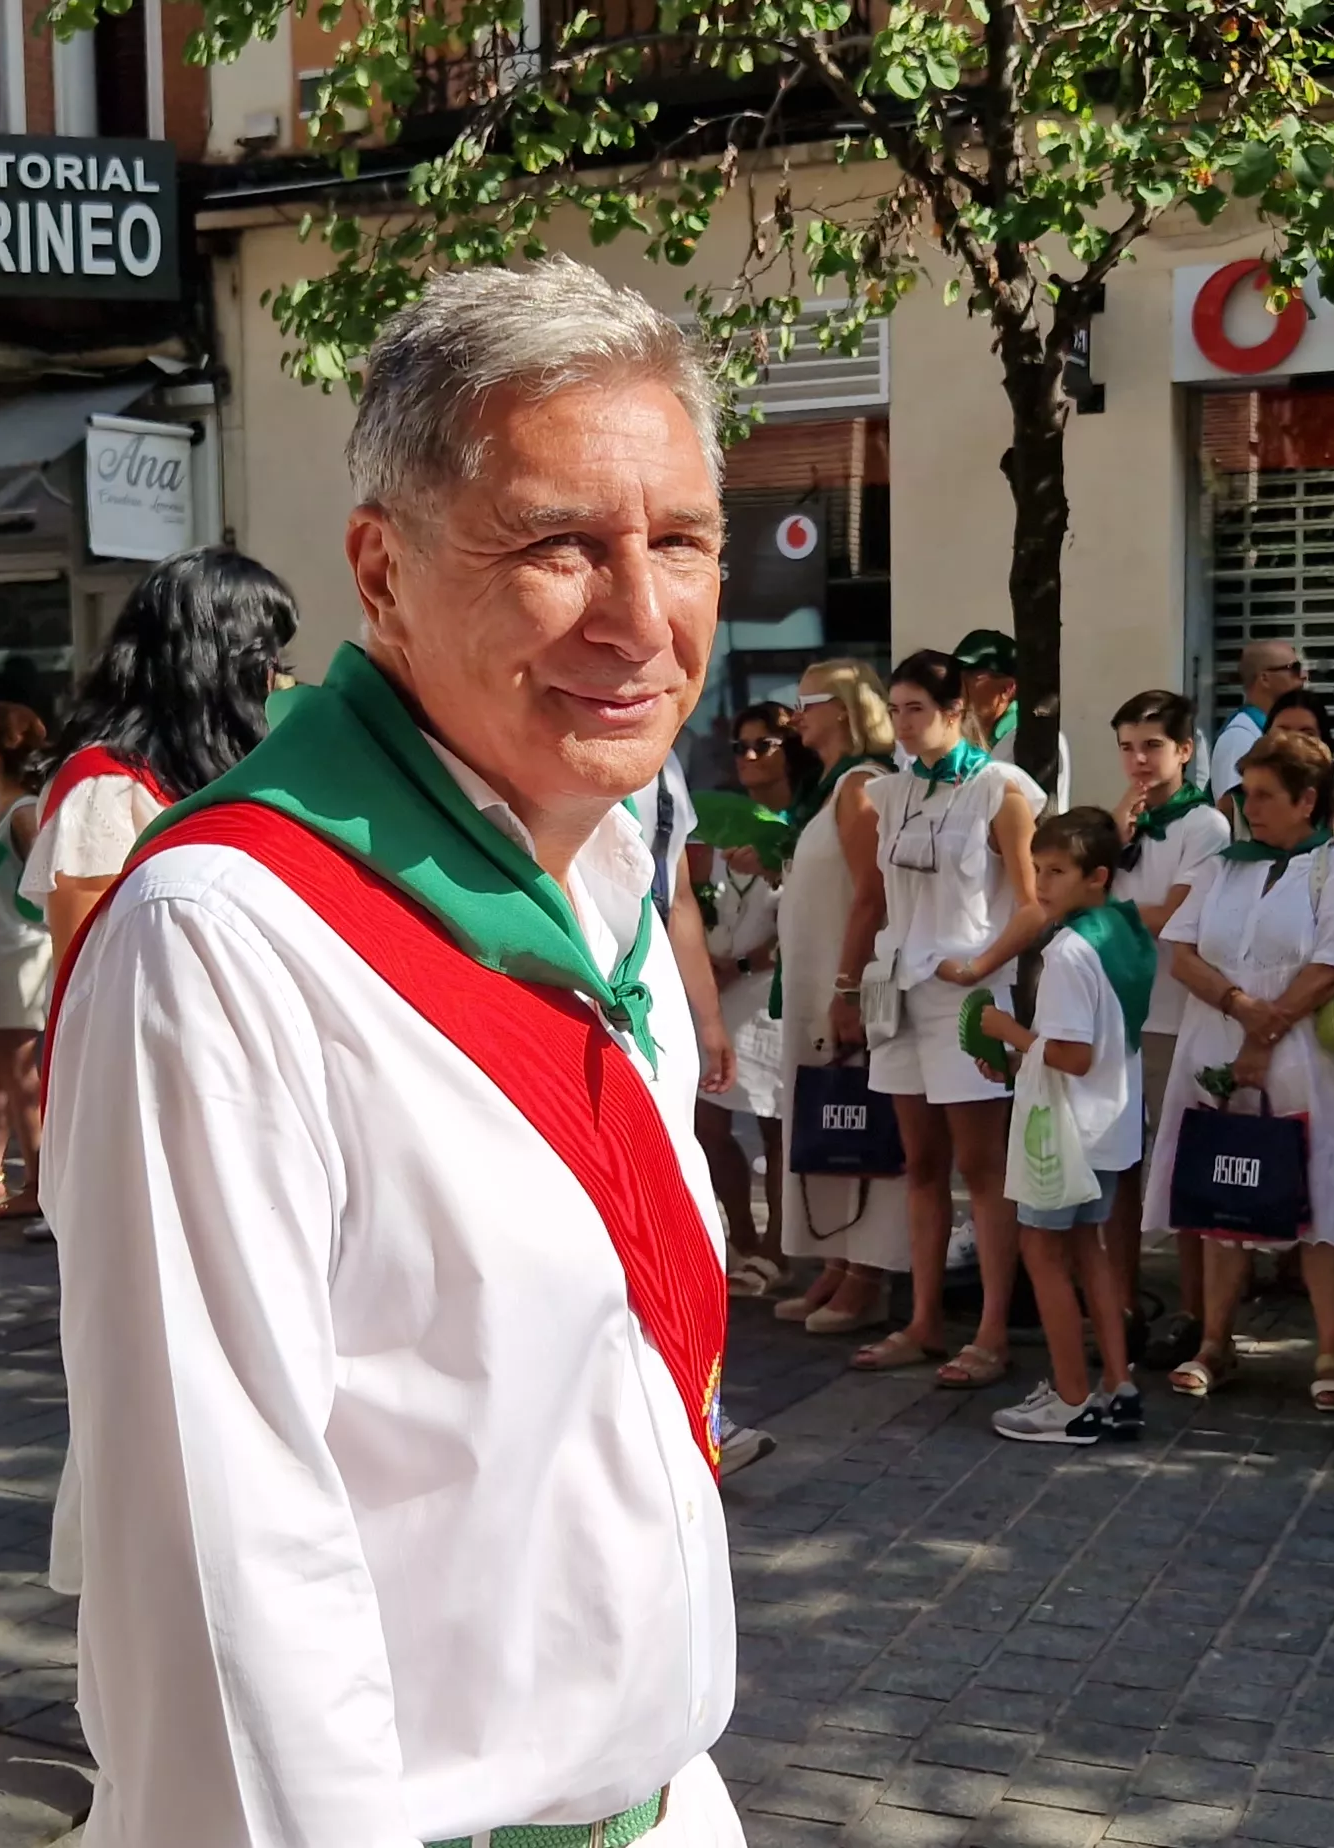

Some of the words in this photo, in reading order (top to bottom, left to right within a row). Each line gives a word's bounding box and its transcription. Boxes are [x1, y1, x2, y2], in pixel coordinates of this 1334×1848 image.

[97, 434, 187, 493] Ana
[822, 1103, 867, 1131] ASCASO
[1212, 1154, 1261, 1188] ASCASO
